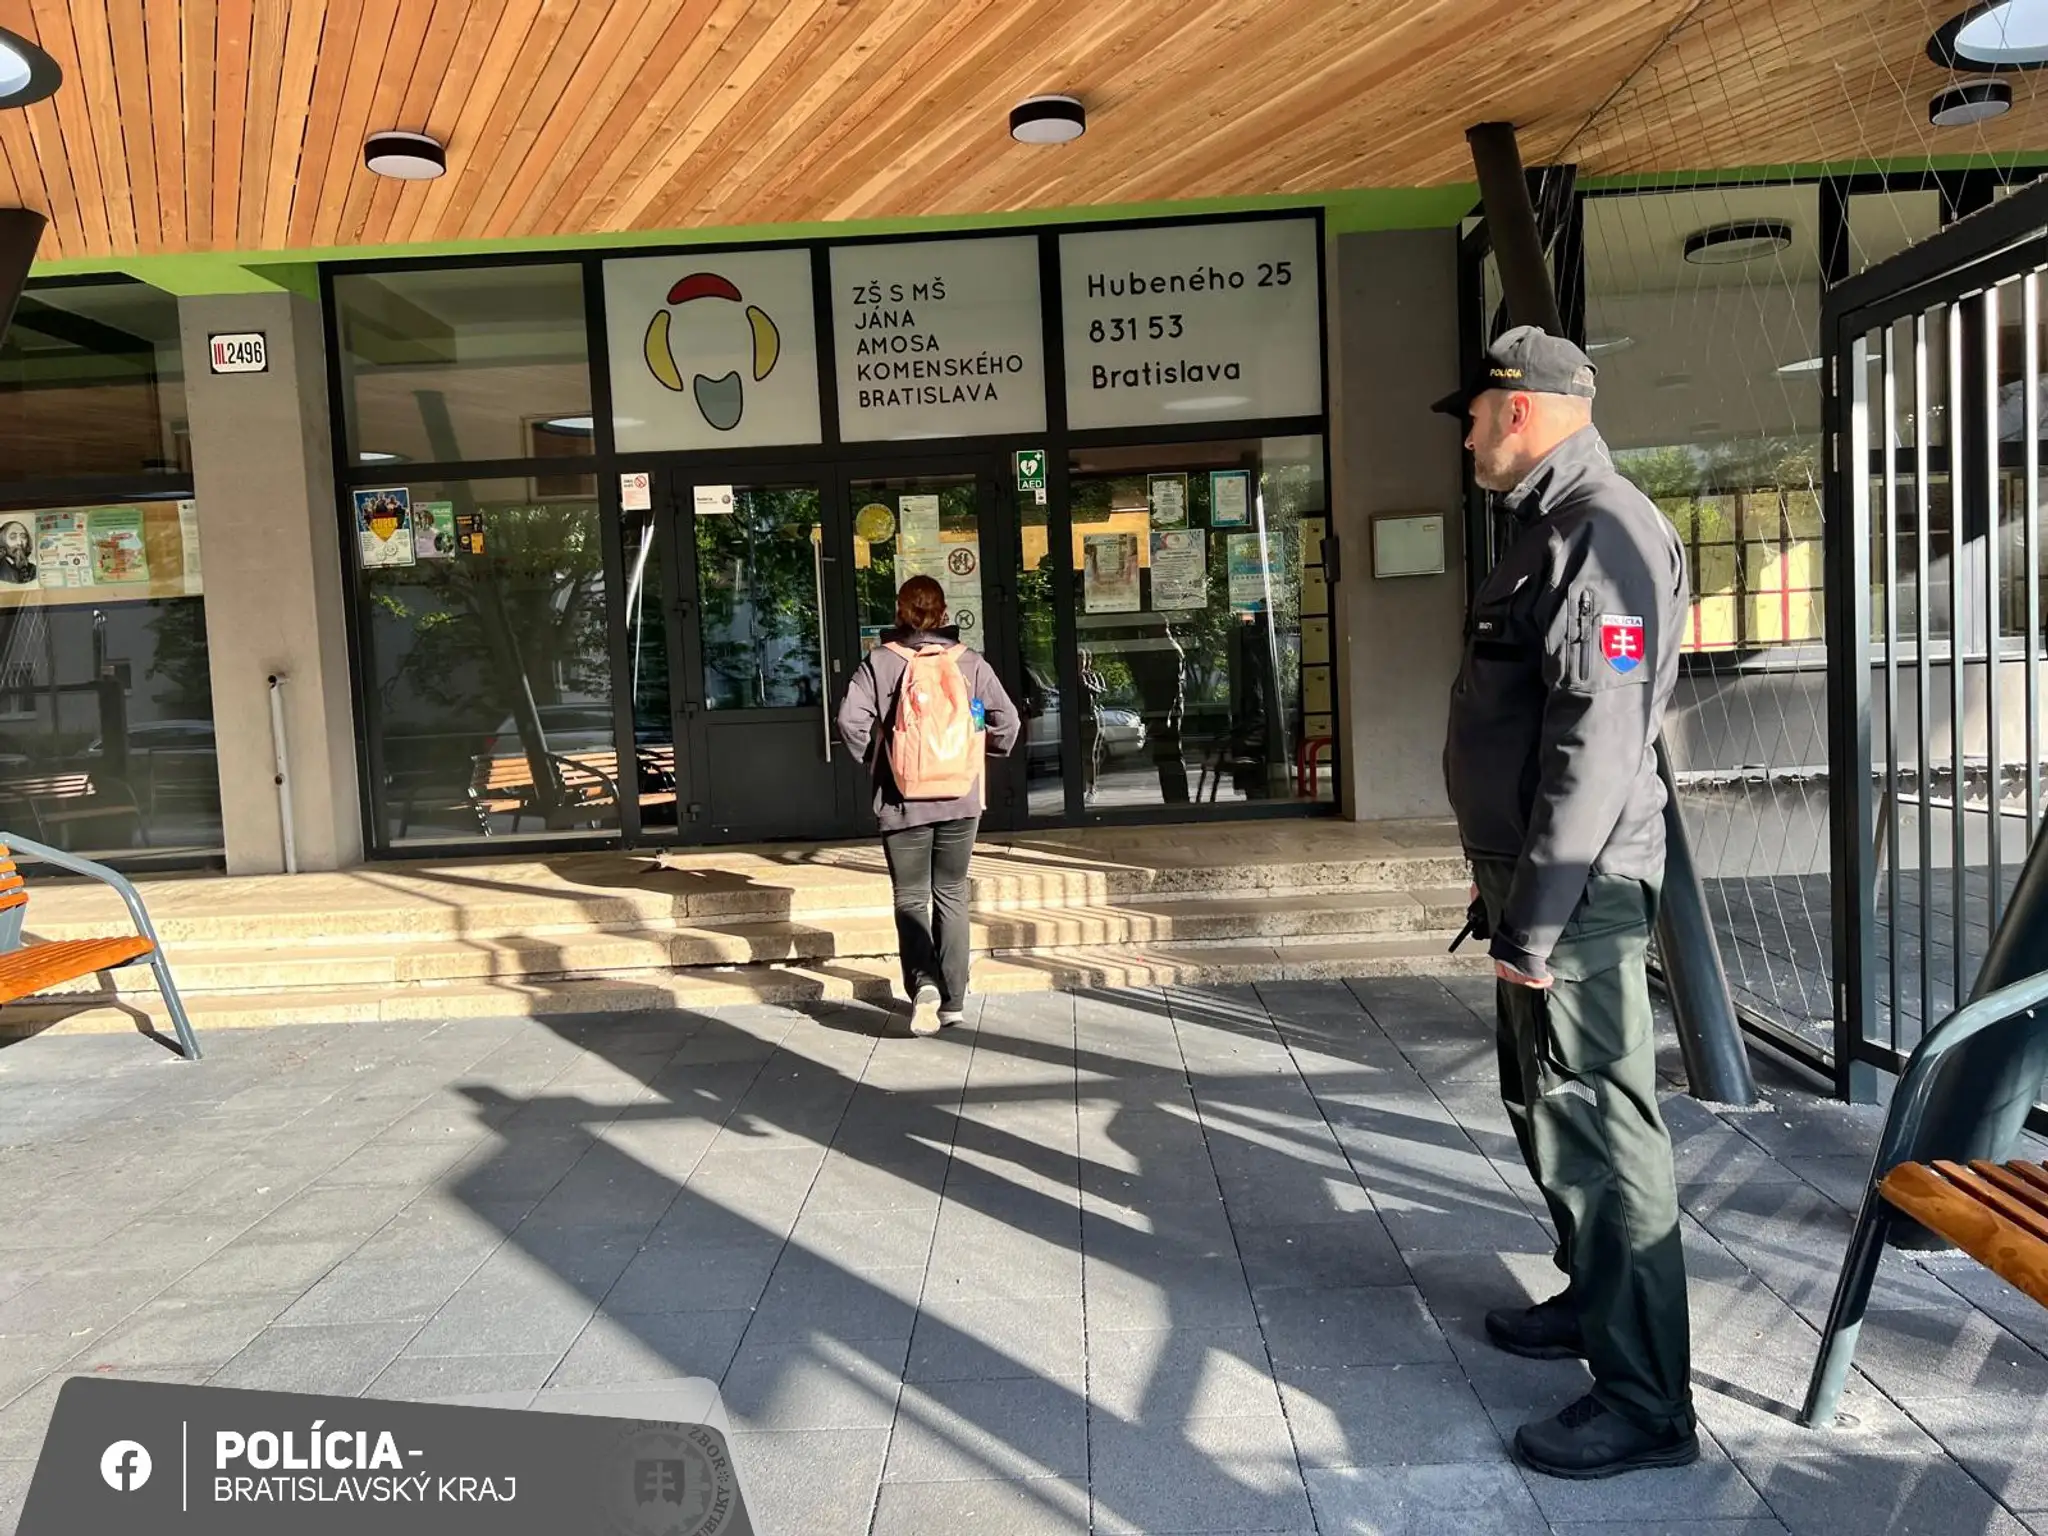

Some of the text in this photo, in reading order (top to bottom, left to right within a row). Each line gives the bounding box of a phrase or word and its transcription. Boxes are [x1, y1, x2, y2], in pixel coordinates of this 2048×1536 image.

[853, 276, 946, 305] ZŠ S MŠ
[1088, 261, 1292, 298] Hubeného 25
[855, 306, 915, 330] JÁNA
[1089, 314, 1184, 343] 831 53
[856, 334, 940, 356] AMOSA
[857, 351, 1023, 381] KOMENSKÉHO
[1092, 359, 1240, 389] Bratislava
[859, 382, 998, 408] BRATISLAVA
[1021, 480, 1042, 489] AED
